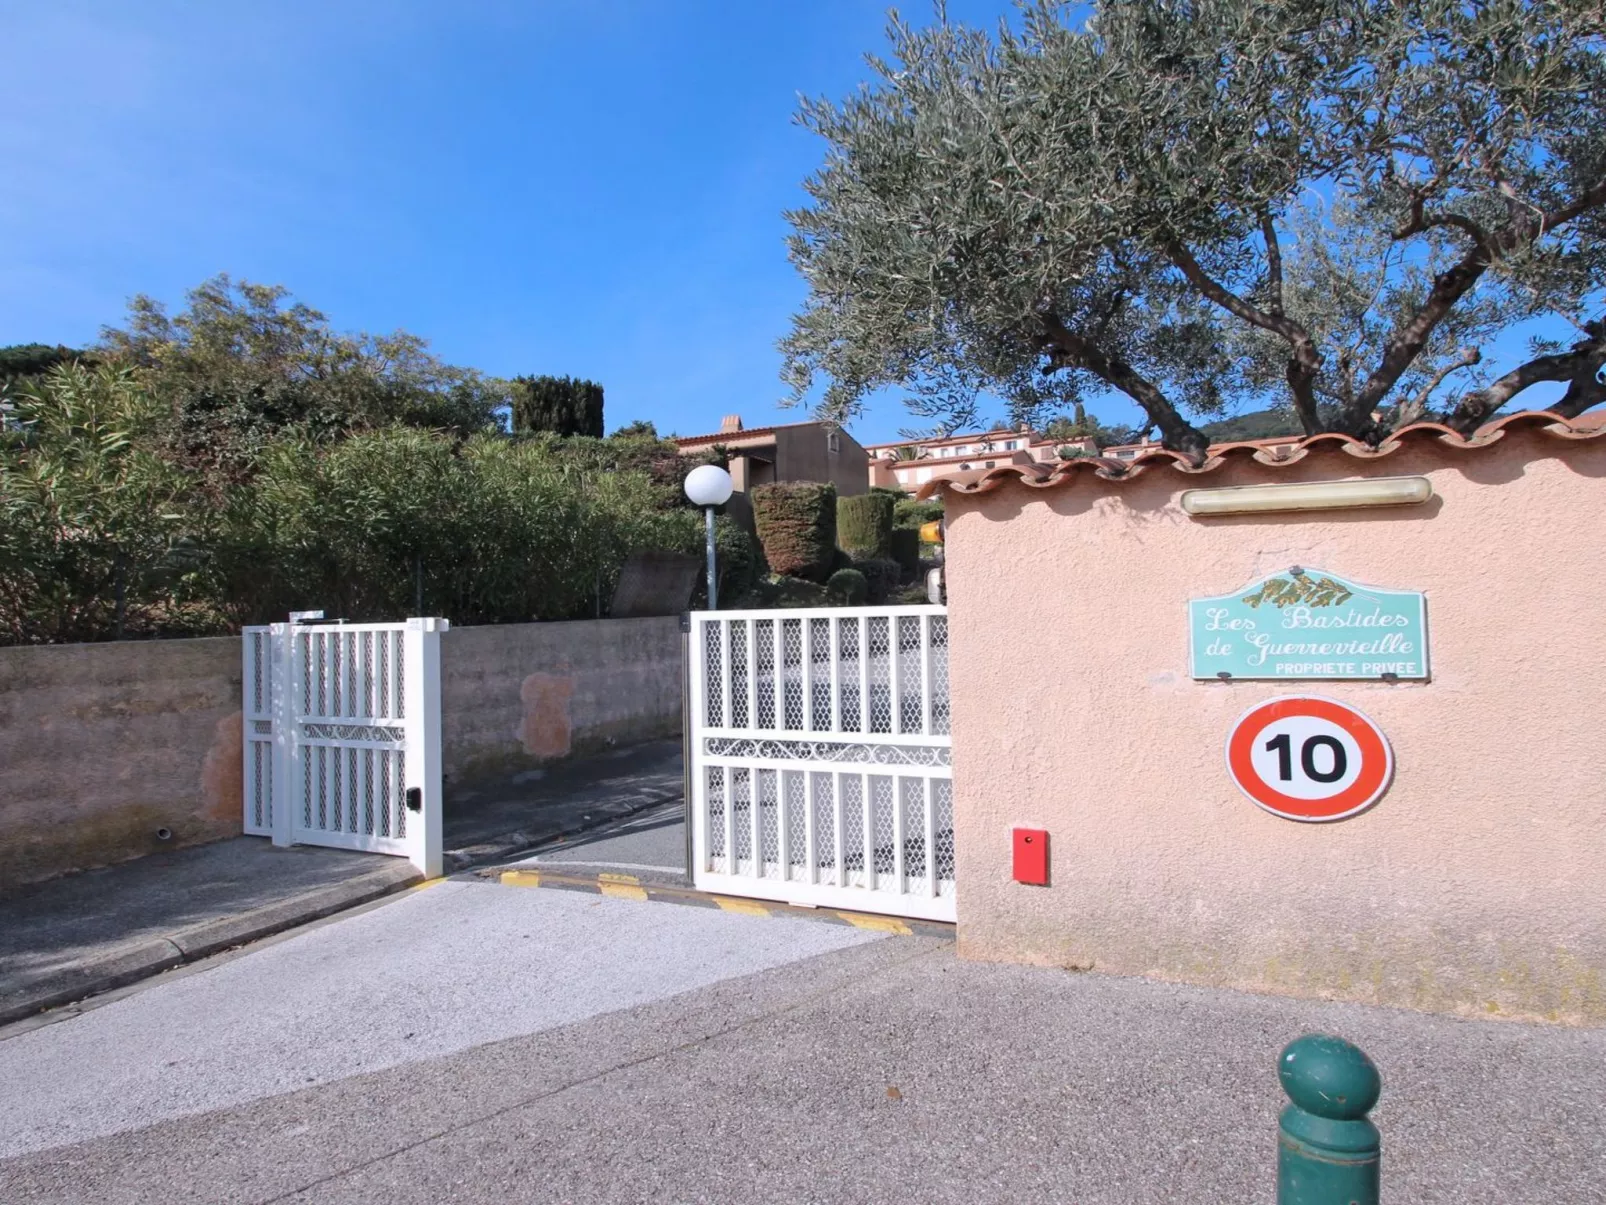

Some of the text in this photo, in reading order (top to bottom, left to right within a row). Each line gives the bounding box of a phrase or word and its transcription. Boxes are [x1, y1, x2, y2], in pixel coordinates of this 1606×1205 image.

[1205, 606, 1409, 631] Les Bastides
[1204, 637, 1233, 656] de
[1276, 662, 1417, 674] PROPRIETE PRIVEE
[1265, 733, 1347, 783] 10
